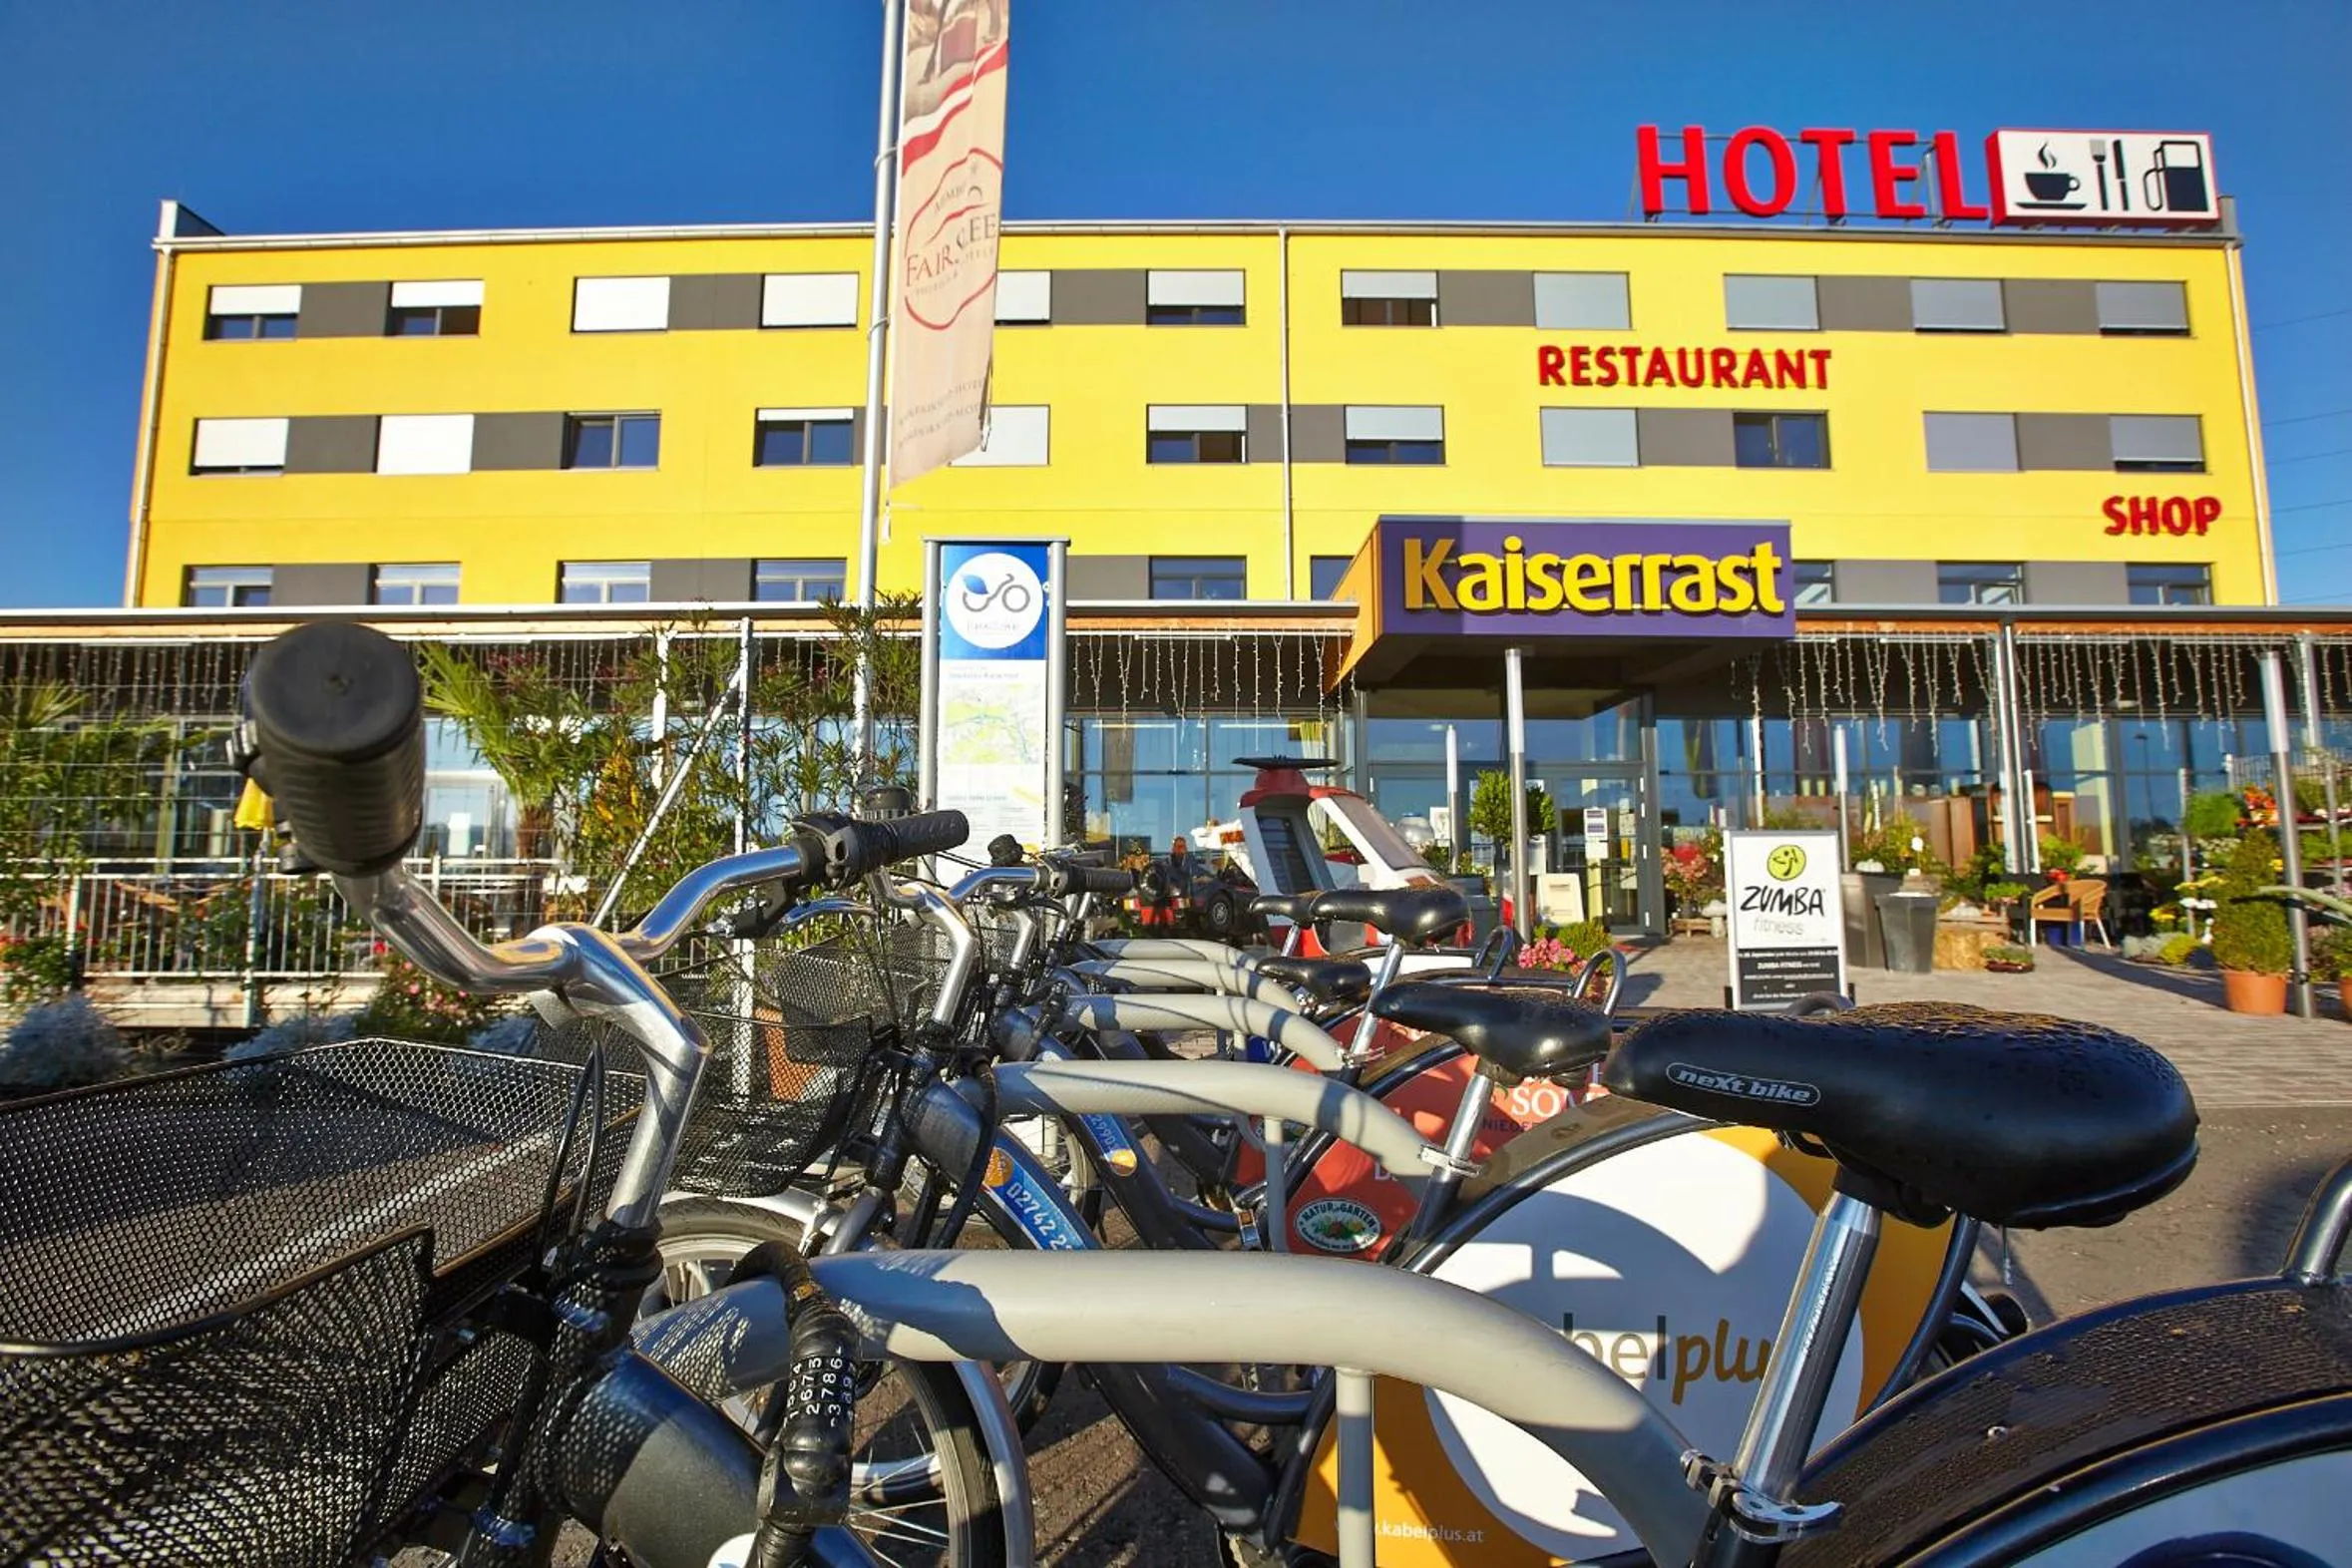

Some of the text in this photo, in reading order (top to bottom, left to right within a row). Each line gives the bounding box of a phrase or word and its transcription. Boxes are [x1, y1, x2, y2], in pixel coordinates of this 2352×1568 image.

[1638, 125, 1988, 220] HOTEL
[1537, 345, 1831, 390] RESTAURANT
[2102, 495, 2222, 537] SHOP
[1403, 535, 1785, 614] Kaiserrast
[1740, 885, 1825, 917] ZUMBA
[1749, 1080, 1810, 1102] bike
[1005, 1182, 1057, 1236] 02742
